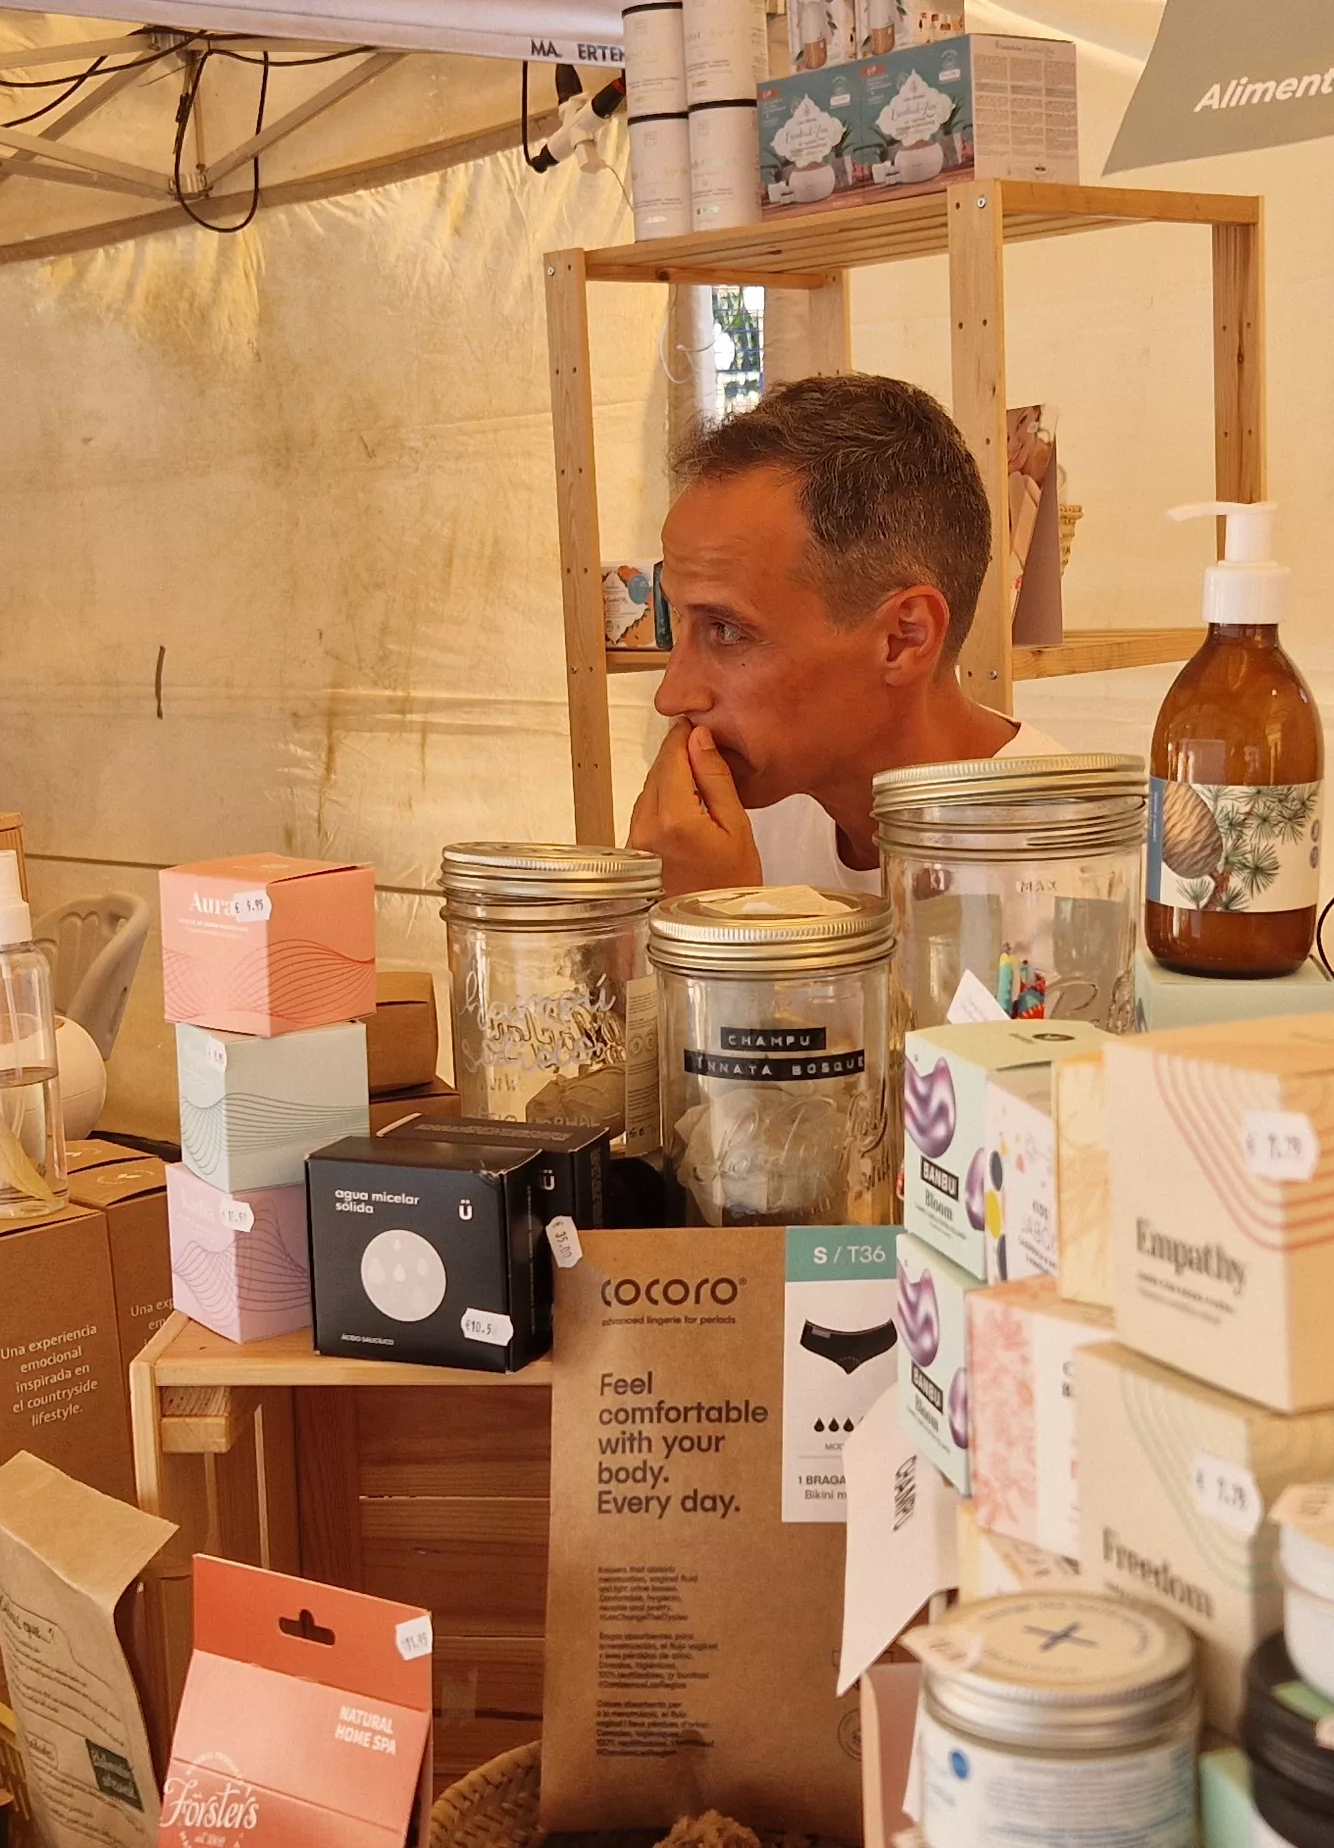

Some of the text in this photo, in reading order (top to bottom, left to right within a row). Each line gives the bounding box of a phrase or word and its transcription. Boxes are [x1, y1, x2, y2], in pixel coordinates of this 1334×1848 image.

[1020, 880, 1058, 893] MAX
[728, 1034, 811, 1048] CHAMPU
[922, 1158, 958, 1197] BANBU
[335, 1189, 420, 1206] agua micelar
[335, 1201, 375, 1214] sólida
[925, 1188, 953, 1222] Bloom
[813, 1247, 828, 1264] S
[847, 1246, 886, 1264] T36
[1136, 1216, 1247, 1297] Empathy
[130, 1303, 154, 1318] Una
[602, 1315, 736, 1327] advanced lingerie for periods
[0, 1324, 98, 1361] Una experiencia
[20, 1346, 83, 1374] emocional
[16, 1364, 91, 1394] inspirada en
[600, 1371, 654, 1397] Feel
[12, 1379, 99, 1414] el countryside
[31, 1403, 84, 1427] lifestyle.
[598, 1401, 769, 1426] comfortable
[598, 1432, 725, 1460] with your
[598, 1461, 671, 1488] body.
[805, 1475, 847, 1486] BRAGA
[598, 1488, 742, 1519] Every day.
[804, 1489, 834, 1500] Bikini
[1103, 1525, 1215, 1620] Freedom
[338, 1704, 394, 1734] NATURAL
[334, 1723, 397, 1755] HOME SPA
